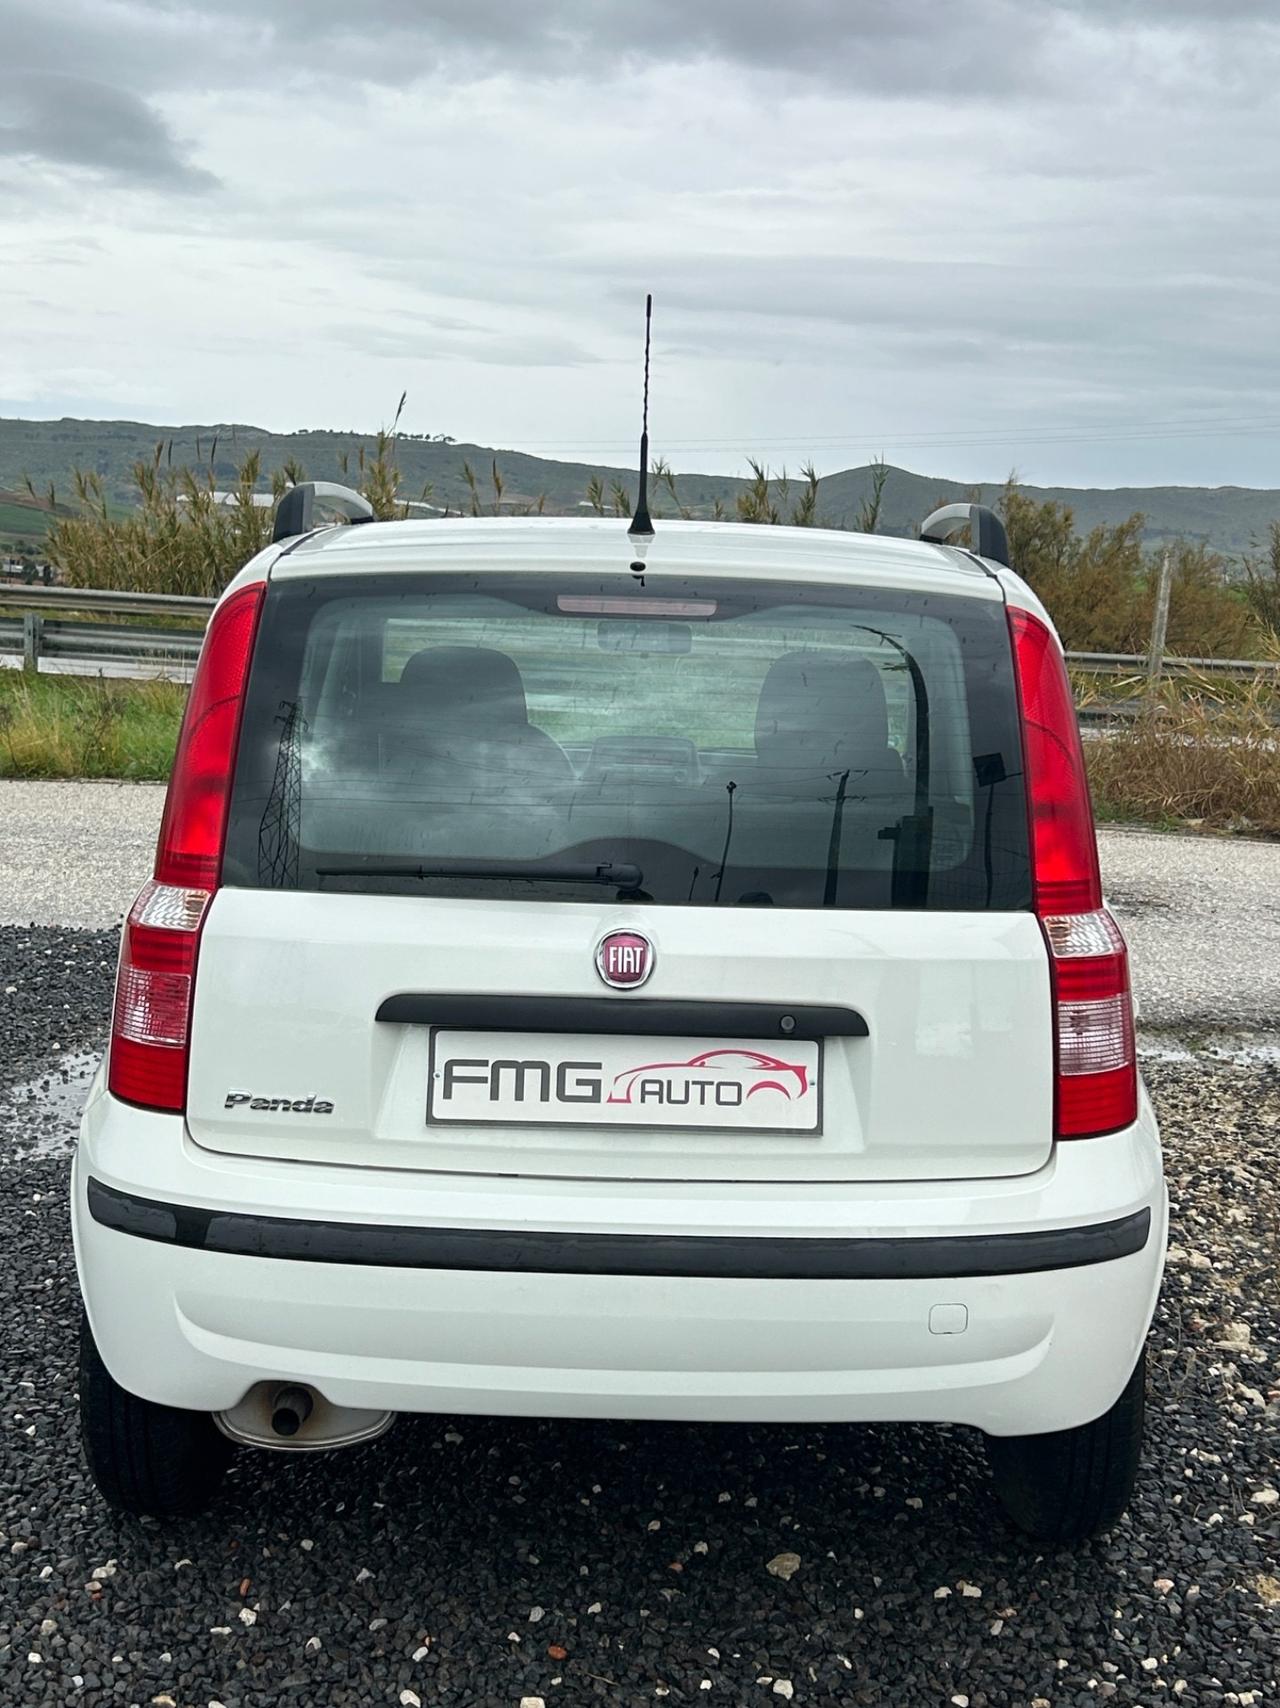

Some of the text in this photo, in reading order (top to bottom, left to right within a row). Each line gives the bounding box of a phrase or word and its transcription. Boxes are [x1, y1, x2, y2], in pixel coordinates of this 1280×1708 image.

[609, 946, 644, 974] FIAT
[442, 1060, 743, 1106] FMG AUTO
[224, 1090, 335, 1114] Panda
